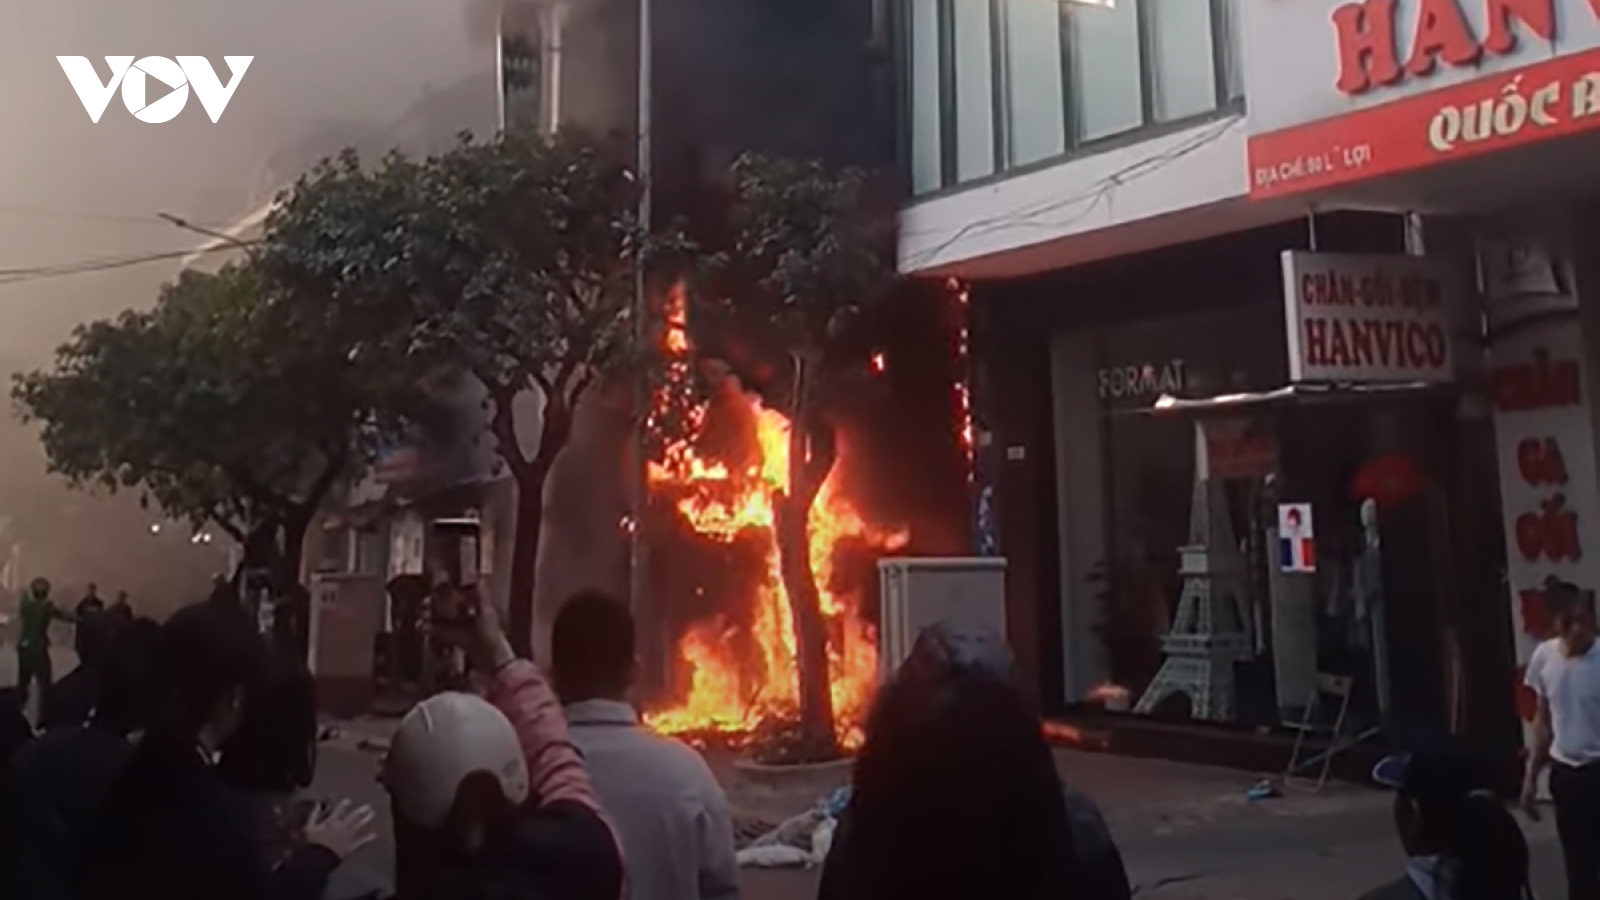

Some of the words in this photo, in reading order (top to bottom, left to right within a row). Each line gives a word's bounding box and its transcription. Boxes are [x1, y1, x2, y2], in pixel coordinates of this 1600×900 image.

[1331, 0, 1600, 95] HAN
[1428, 74, 1561, 151] QUỐC
[1305, 317, 1446, 369] HANVICO
[1097, 358, 1185, 398] FORMAT
